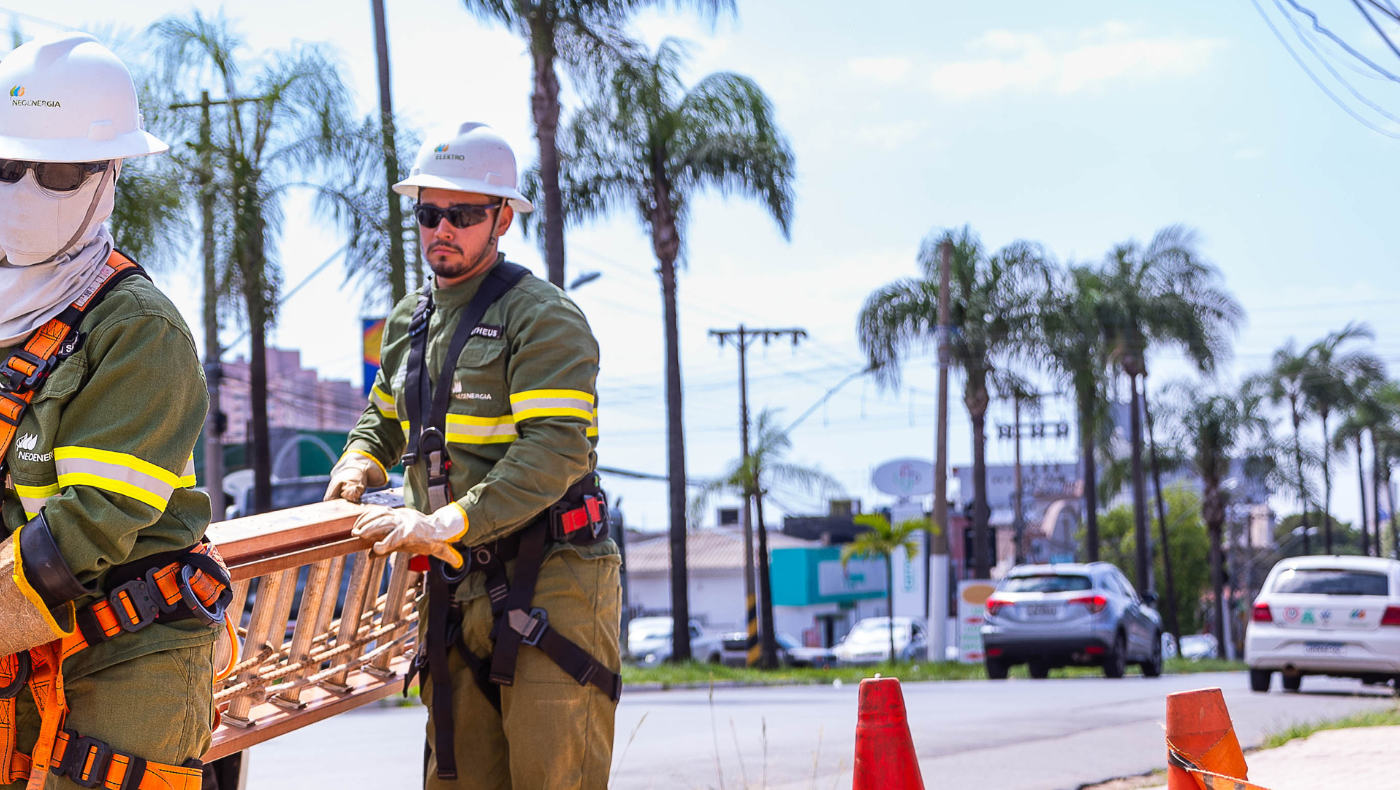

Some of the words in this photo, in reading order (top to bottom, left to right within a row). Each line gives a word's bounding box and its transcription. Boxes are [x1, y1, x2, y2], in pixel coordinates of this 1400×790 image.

[12, 100, 61, 108] NEOENERGIA
[470, 326, 498, 337] THEUS
[18, 450, 54, 462] NEOENER
